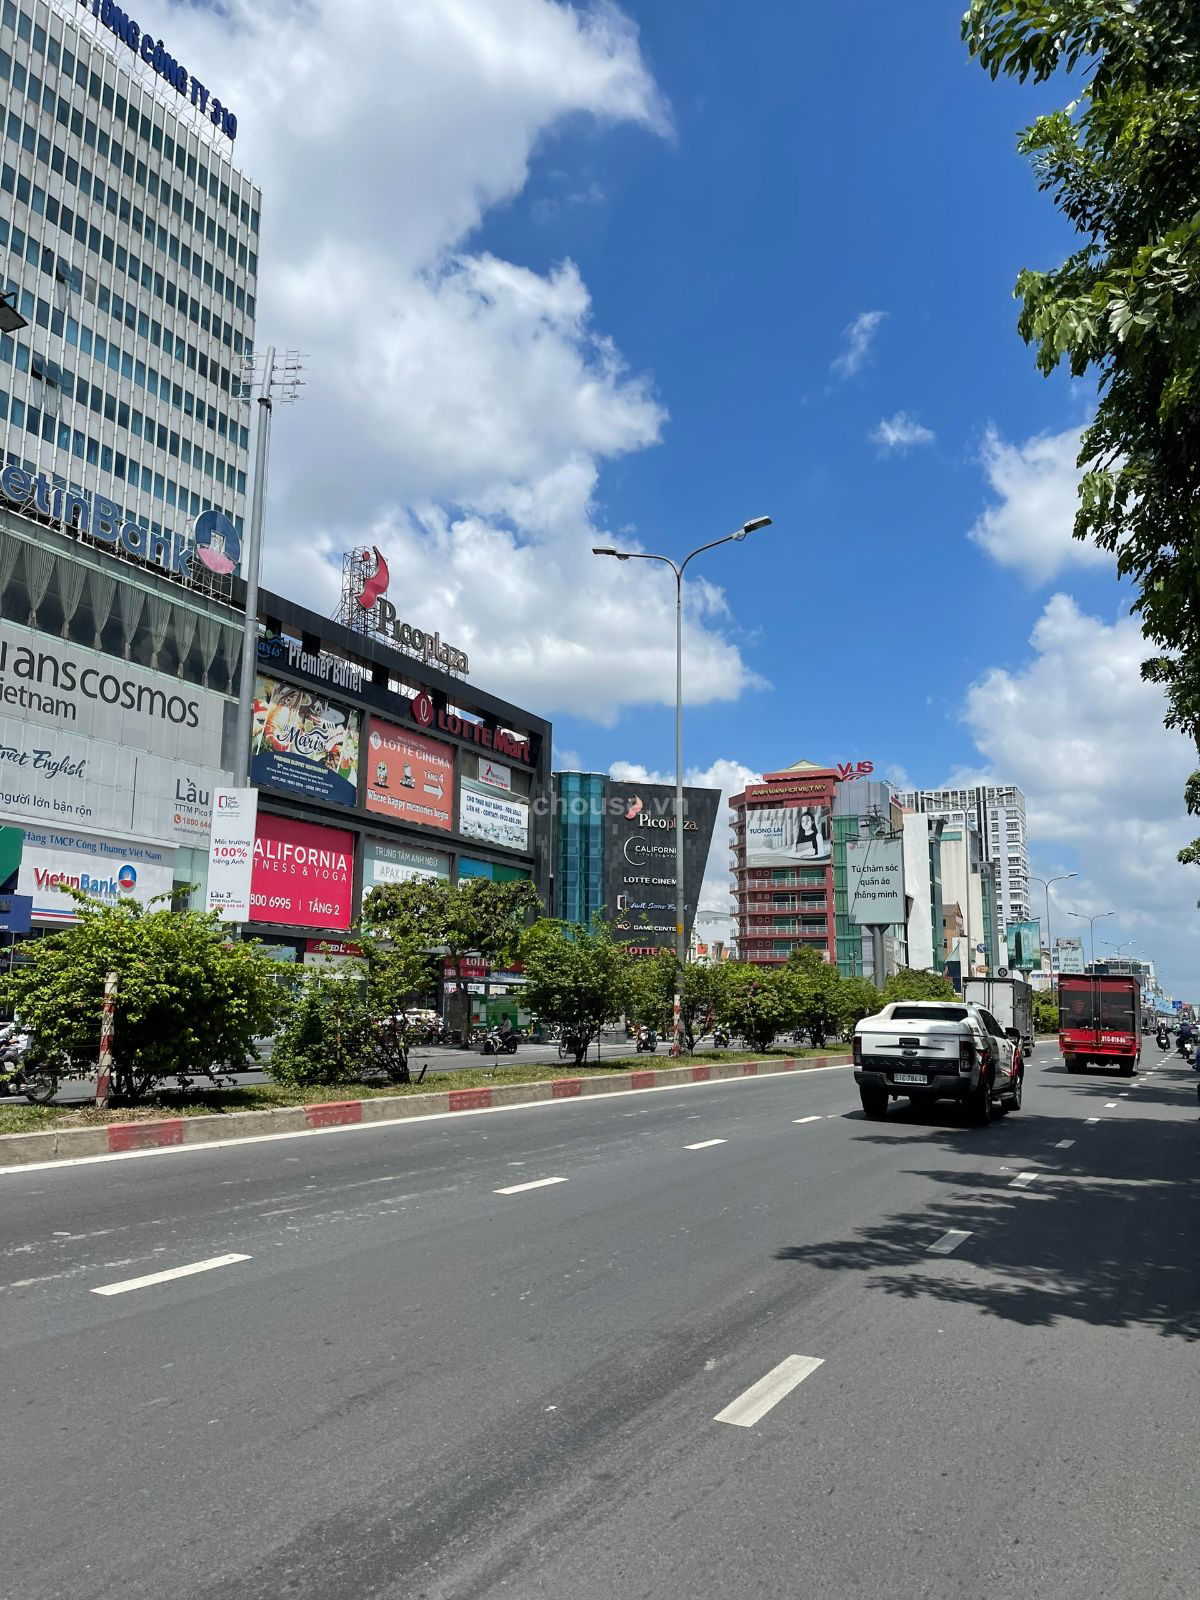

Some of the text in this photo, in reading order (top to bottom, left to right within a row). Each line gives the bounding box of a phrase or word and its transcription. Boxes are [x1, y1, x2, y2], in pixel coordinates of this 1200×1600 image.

[190, 76, 210, 114] TY
[211, 98, 237, 140] 319
[288, 640, 332, 681] Premier
[333, 658, 363, 694] Buffet
[438, 708, 529, 763] LOTTE Mart
[33, 749, 87, 779] English
[383, 738, 450, 769] LOTTE CINEMA
[438, 772, 444, 784] 4
[175, 778, 209, 806] Lầu
[33, 795, 50, 809] lớn
[53, 798, 72, 814] bận
[75, 804, 92, 818] rộn
[174, 802, 193, 814] TTTM
[367, 788, 449, 821] Where happy memories begin
[24, 832, 46, 845] Hàng
[50, 835, 74, 848] TMCP
[145, 851, 162, 860] Nam
[213, 848, 248, 858] 100%
[253, 838, 347, 872] ALIFORNIA
[375, 846, 397, 859] TRUNG
[411, 854, 426, 865] ANH
[635, 845, 677, 854] CALIFORNI
[34, 868, 118, 892] VietinBank
[302, 866, 308, 876] &
[314, 868, 347, 882] YOGA
[380, 865, 400, 880] APAX
[624, 876, 677, 885] LOTTE CINEM
[226, 891, 232, 899] 3
[854, 890, 898, 901] thông minh
[269, 896, 291, 910] 6995
[309, 897, 333, 915] TẦNG
[334, 904, 340, 916] 2
